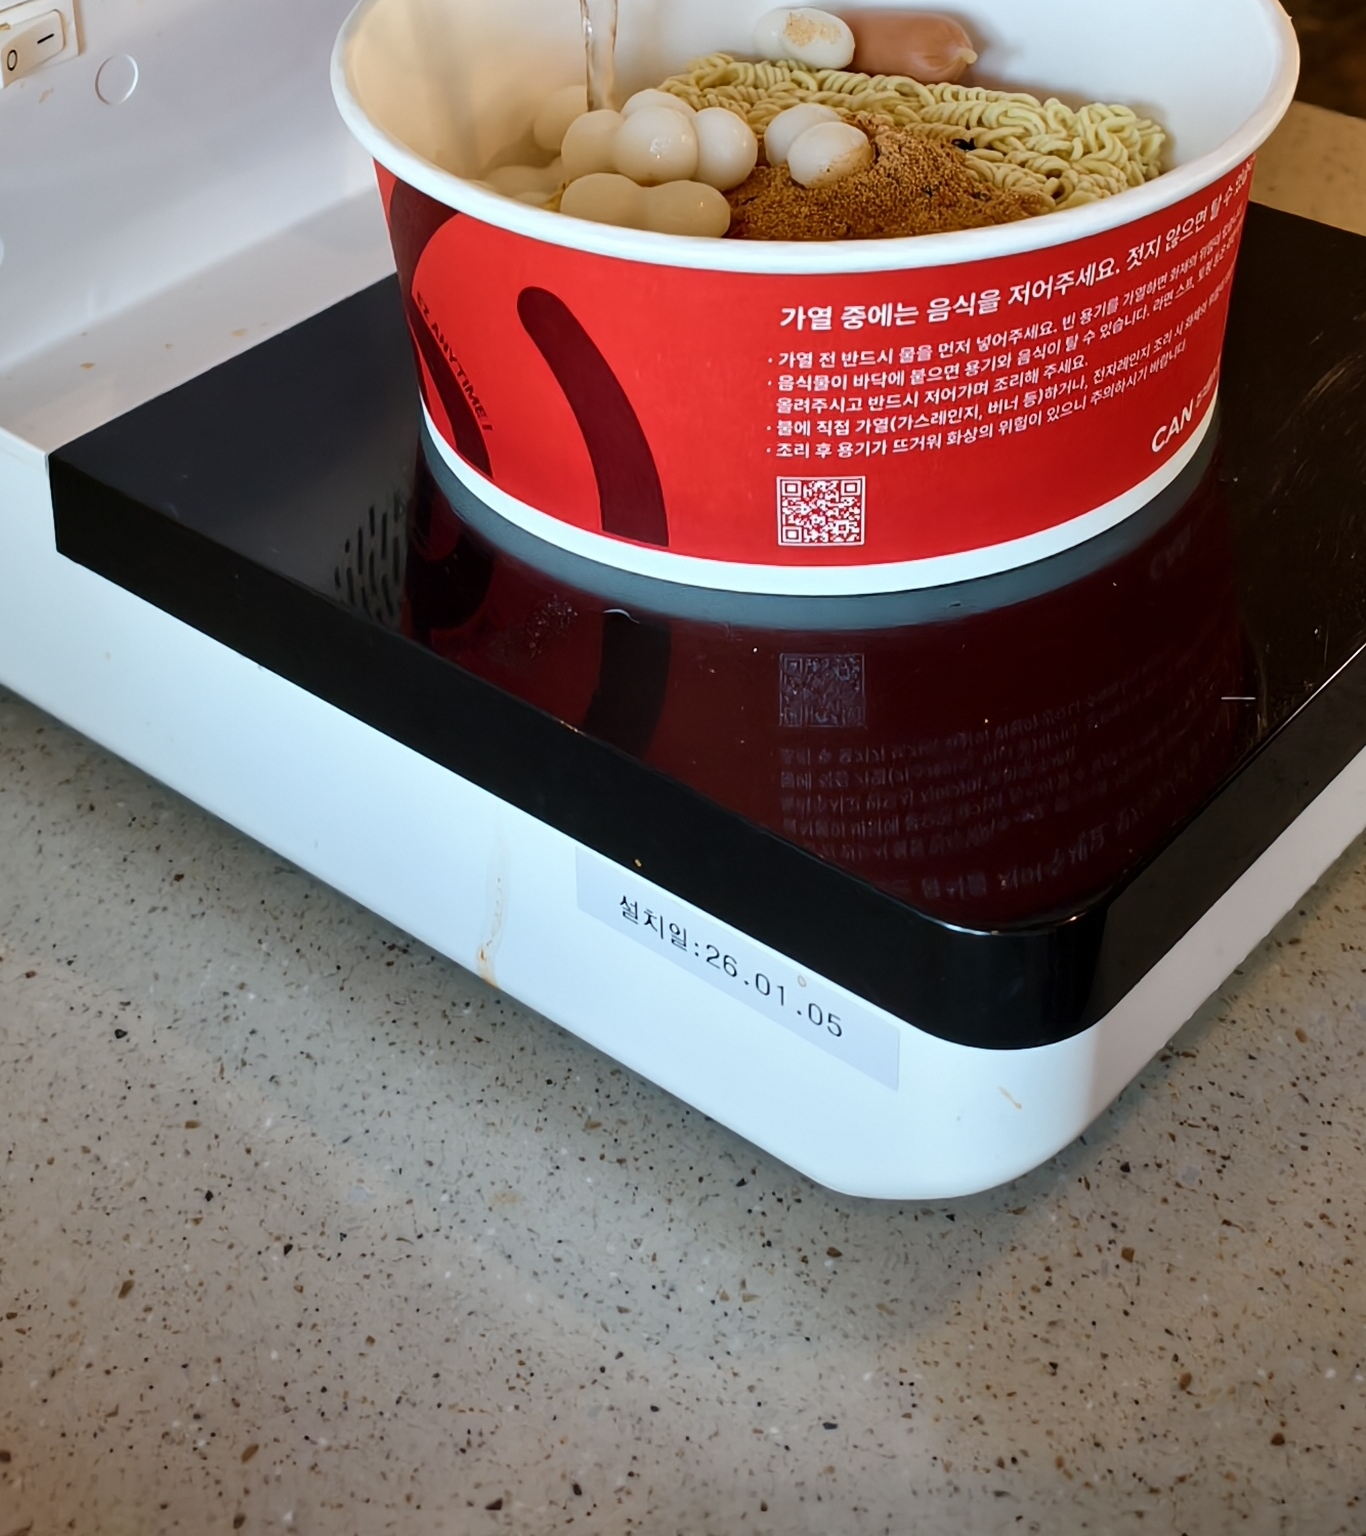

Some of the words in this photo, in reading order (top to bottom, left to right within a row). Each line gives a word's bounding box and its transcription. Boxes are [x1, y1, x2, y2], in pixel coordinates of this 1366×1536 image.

[779, 305, 833, 331] 가열
[840, 302, 920, 331] 중에는
[926, 289, 1001, 323] 음식을
[1007, 257, 1121, 306] 저어주세요.
[1126, 234, 1162, 272] 젓지
[1165, 206, 1208, 252] 않으면
[777, 373, 848, 392] 음식물이
[852, 369, 905, 391] 바닥에
[964, 351, 1012, 378] 용기와
[1017, 338, 1062, 367] 음식이
[1082, 329, 1096, 345] 수
[778, 350, 813, 370] 가열
[819, 350, 836, 369] 전
[841, 347, 894, 369] 반드시
[938, 337, 972, 359] 먼저
[1062, 311, 1076, 331] 빈
[776, 441, 810, 459] 조리
[814, 441, 833, 459] 후
[837, 438, 888, 459] 용기가
[892, 432, 942, 454] 뜨거워
[946, 422, 994, 446] 화상의
[998, 409, 1043, 437] 위험이
[1046, 395, 1087, 423] 있으니
[1089, 365, 1148, 406] 주의하시기
[868, 390, 919, 412] 반드시
[924, 379, 989, 405] 저어가며
[993, 367, 1040, 393] 조리해
[1043, 354, 1088, 380] 주세요.
[816, 418, 850, 437] 직접
[988, 395, 1019, 415] 버너
[1151, 398, 1194, 453] CAN
[619, 895, 843, 1038] 설치일:26.01.05
